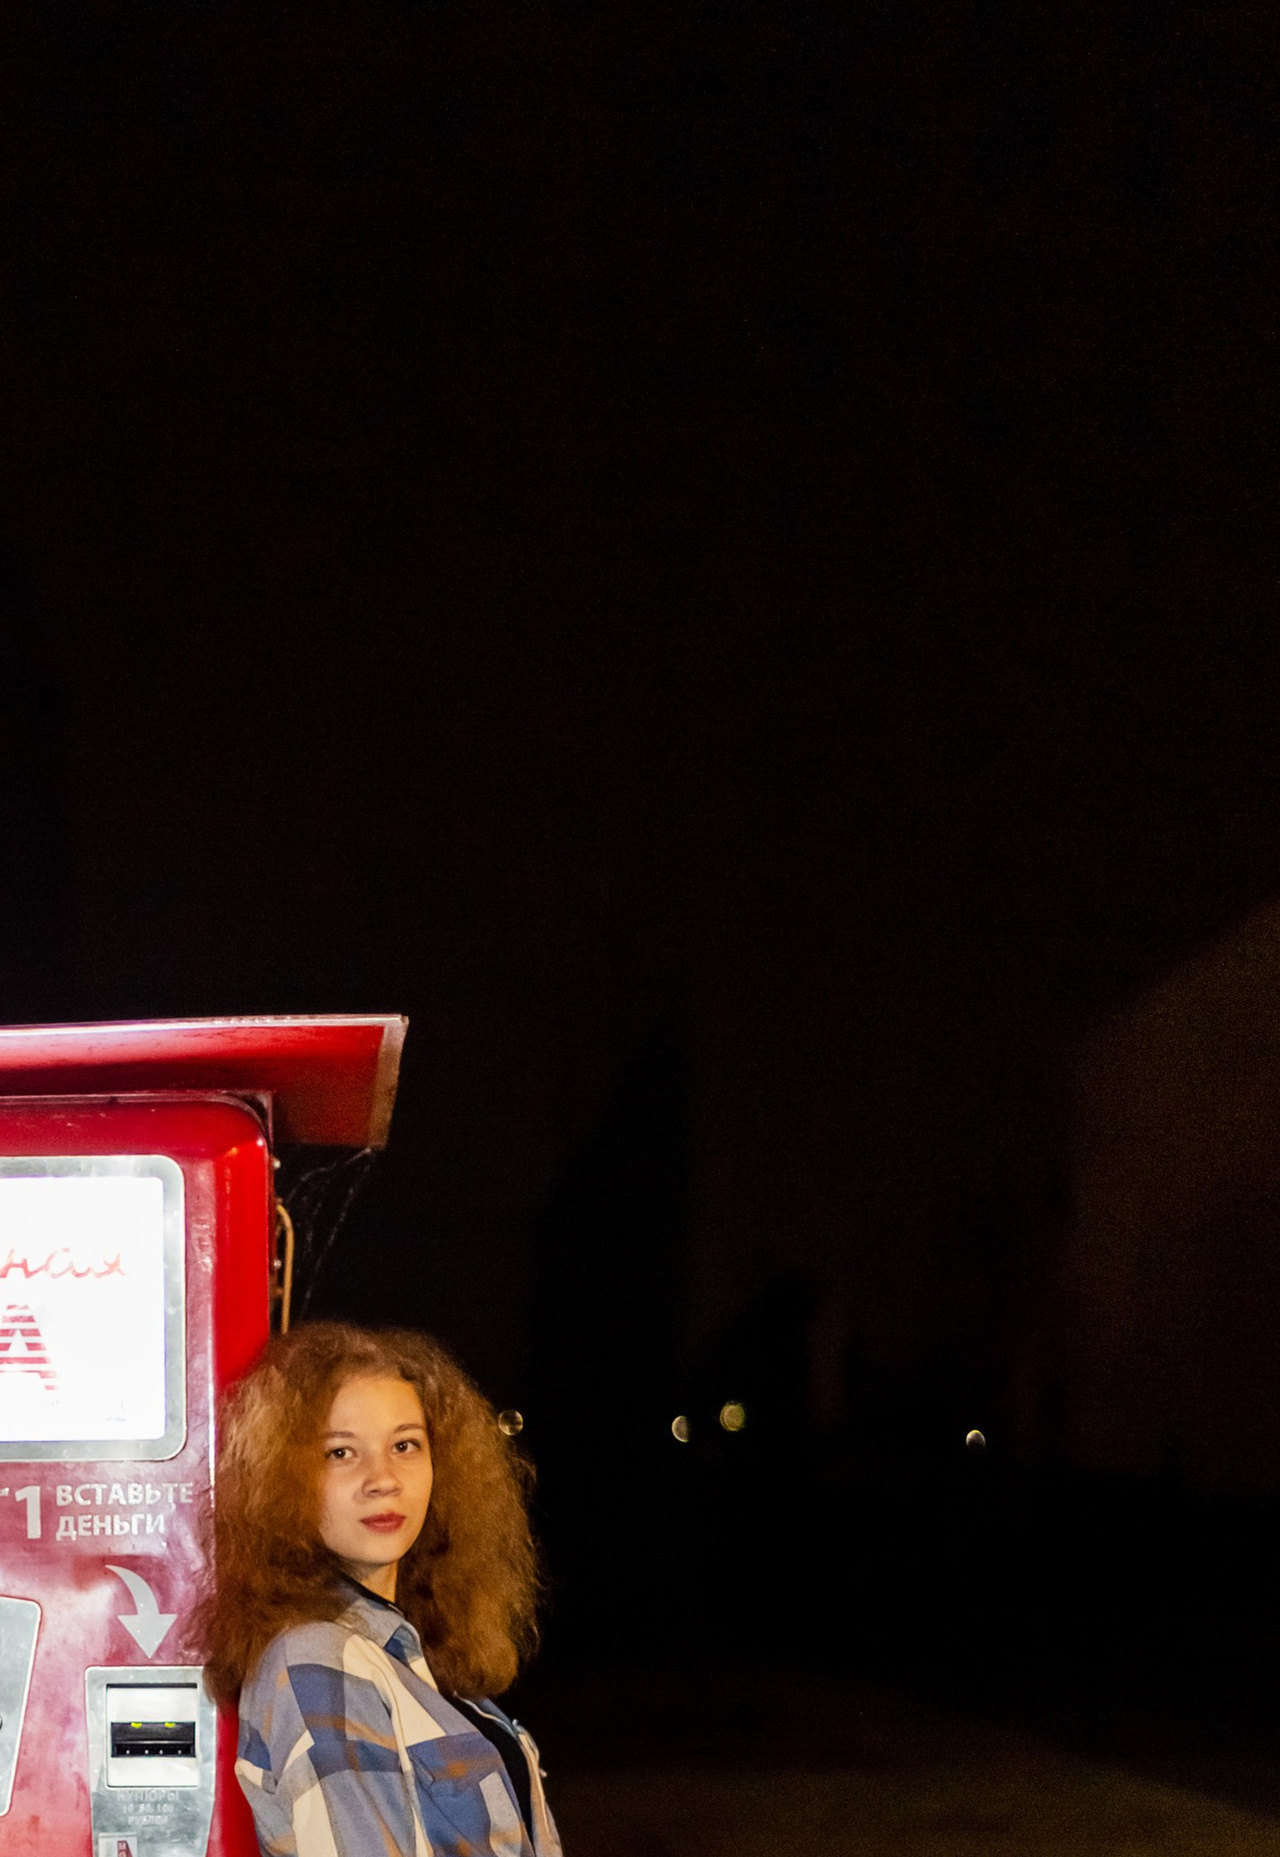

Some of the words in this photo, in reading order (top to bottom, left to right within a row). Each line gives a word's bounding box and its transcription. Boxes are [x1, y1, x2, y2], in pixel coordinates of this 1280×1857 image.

[55, 1482, 194, 1507] ВСТАВЬТЕ
[15, 1485, 42, 1540] 1
[55, 1513, 166, 1541] ДЕНЬГИ
